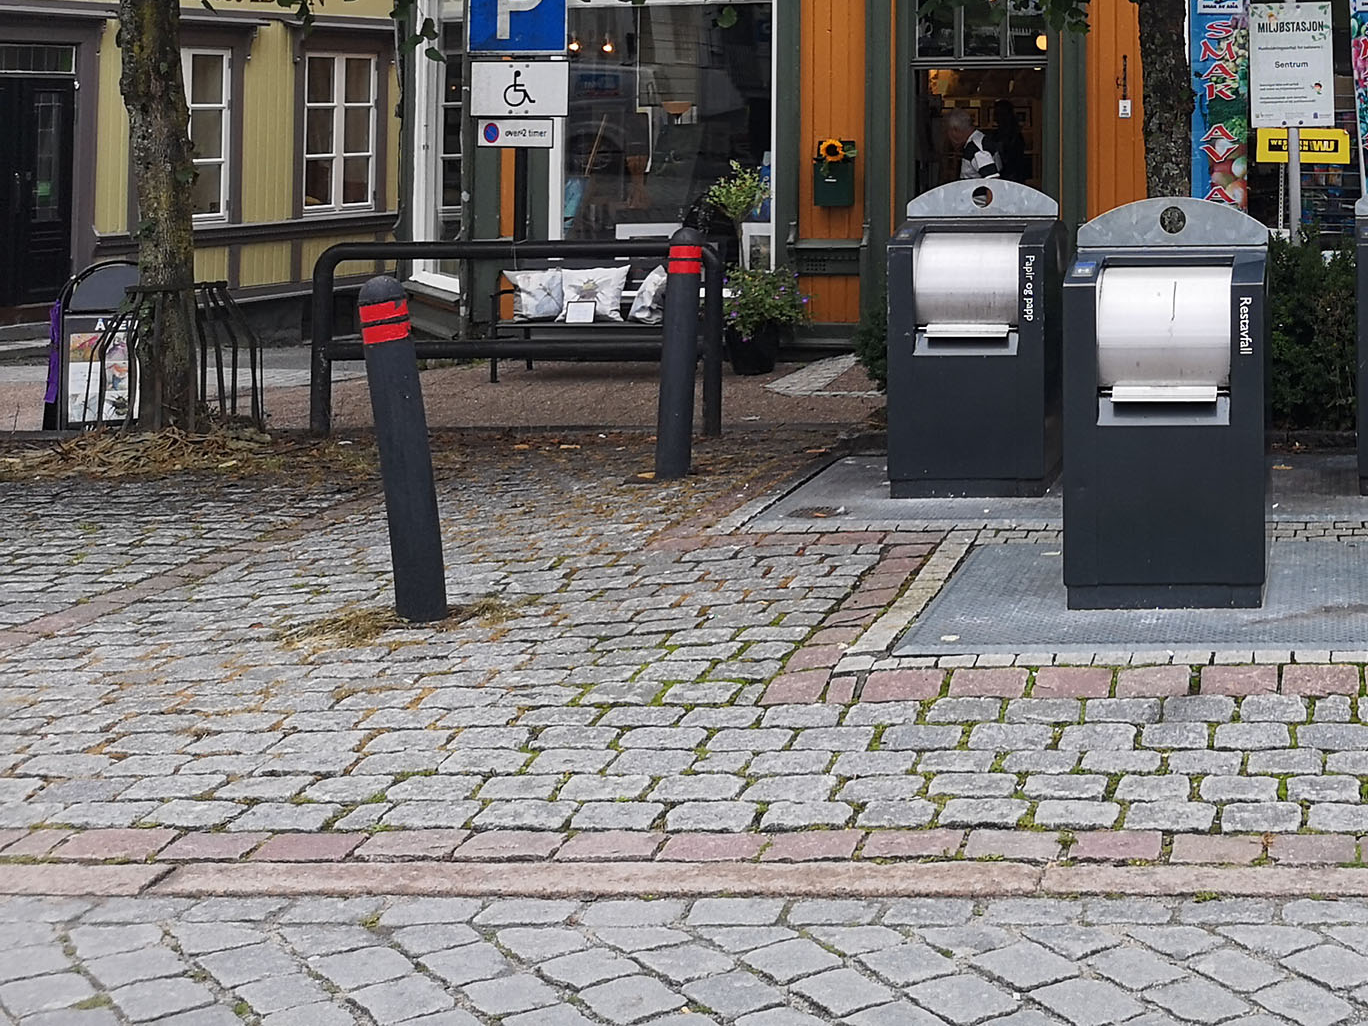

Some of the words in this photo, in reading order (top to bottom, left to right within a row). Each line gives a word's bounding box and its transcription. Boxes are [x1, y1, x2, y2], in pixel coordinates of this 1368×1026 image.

[1257, 20, 1324, 34] MILJØSTASJON
[1200, 21, 1237, 101] SMAK
[1274, 59, 1309, 69] Sentrum
[528, 129, 547, 138] timer
[1200, 124, 1239, 163] AV
[1022, 255, 1035, 281] Papir
[1023, 282, 1034, 296] og
[1023, 297, 1034, 322] papp
[1239, 296, 1253, 355] Restavfall
